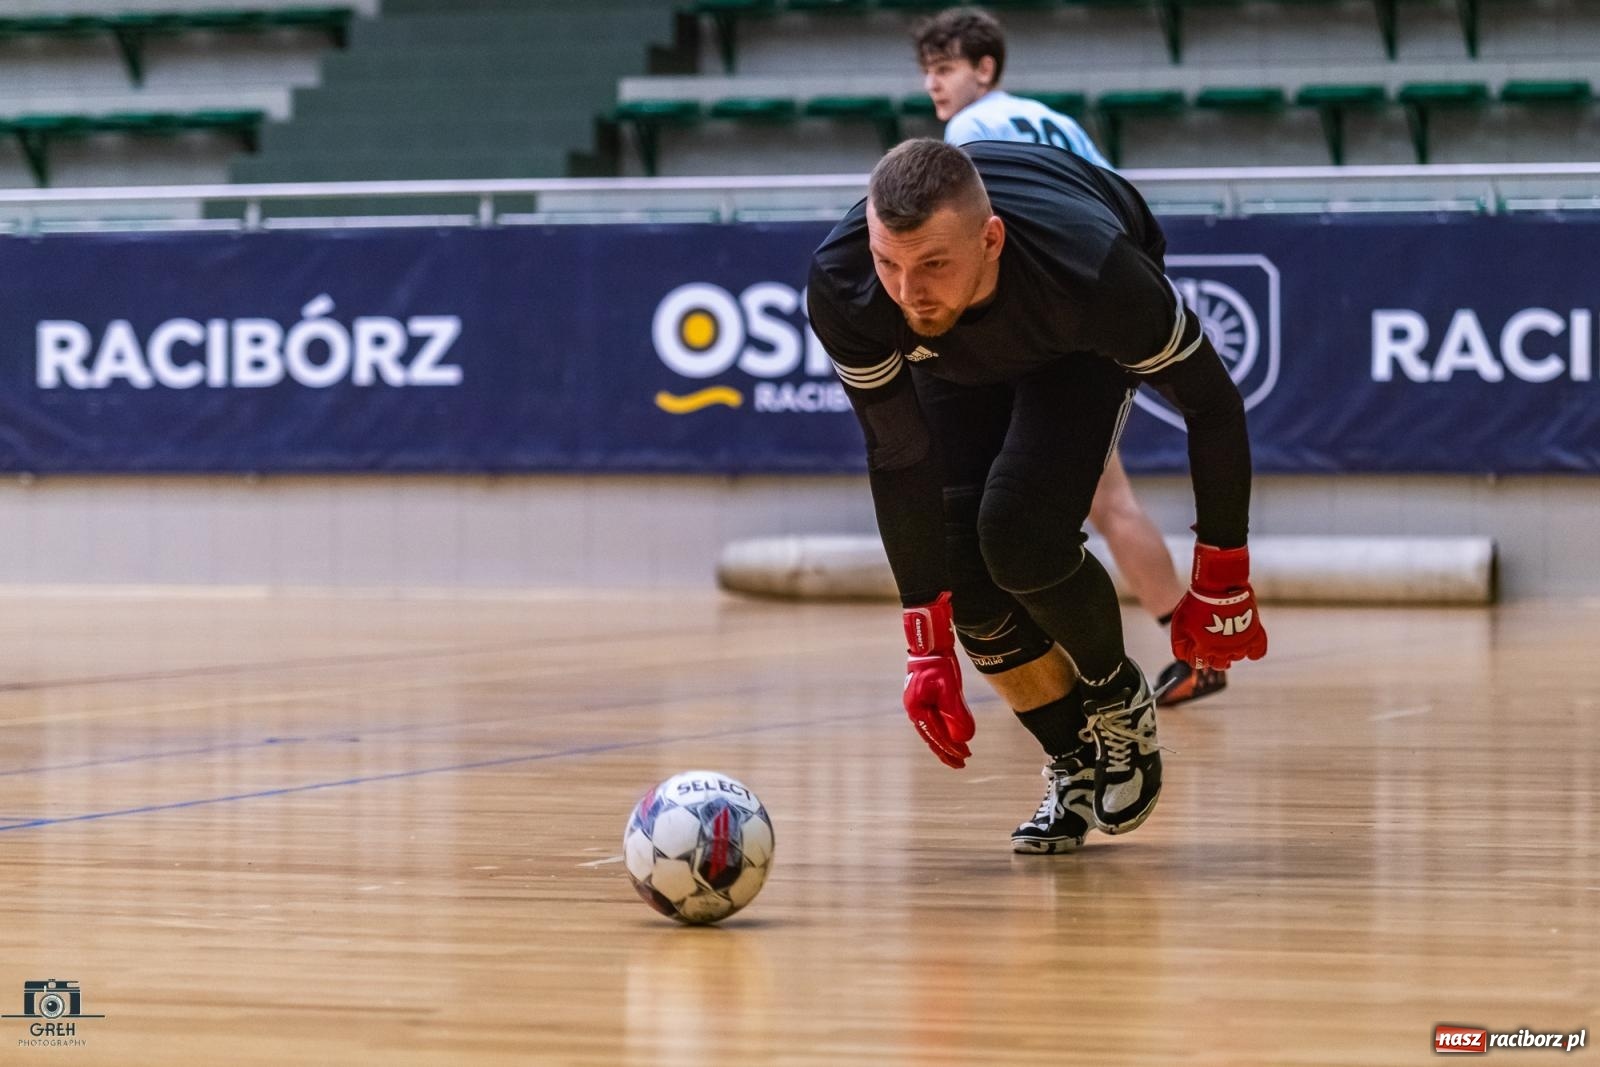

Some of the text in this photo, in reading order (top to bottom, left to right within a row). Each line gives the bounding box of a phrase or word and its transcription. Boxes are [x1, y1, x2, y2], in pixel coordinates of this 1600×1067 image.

[36, 294, 462, 389] RACIBÓRZ
[1371, 307, 1600, 383] RACI
[677, 779, 751, 800] SELECT
